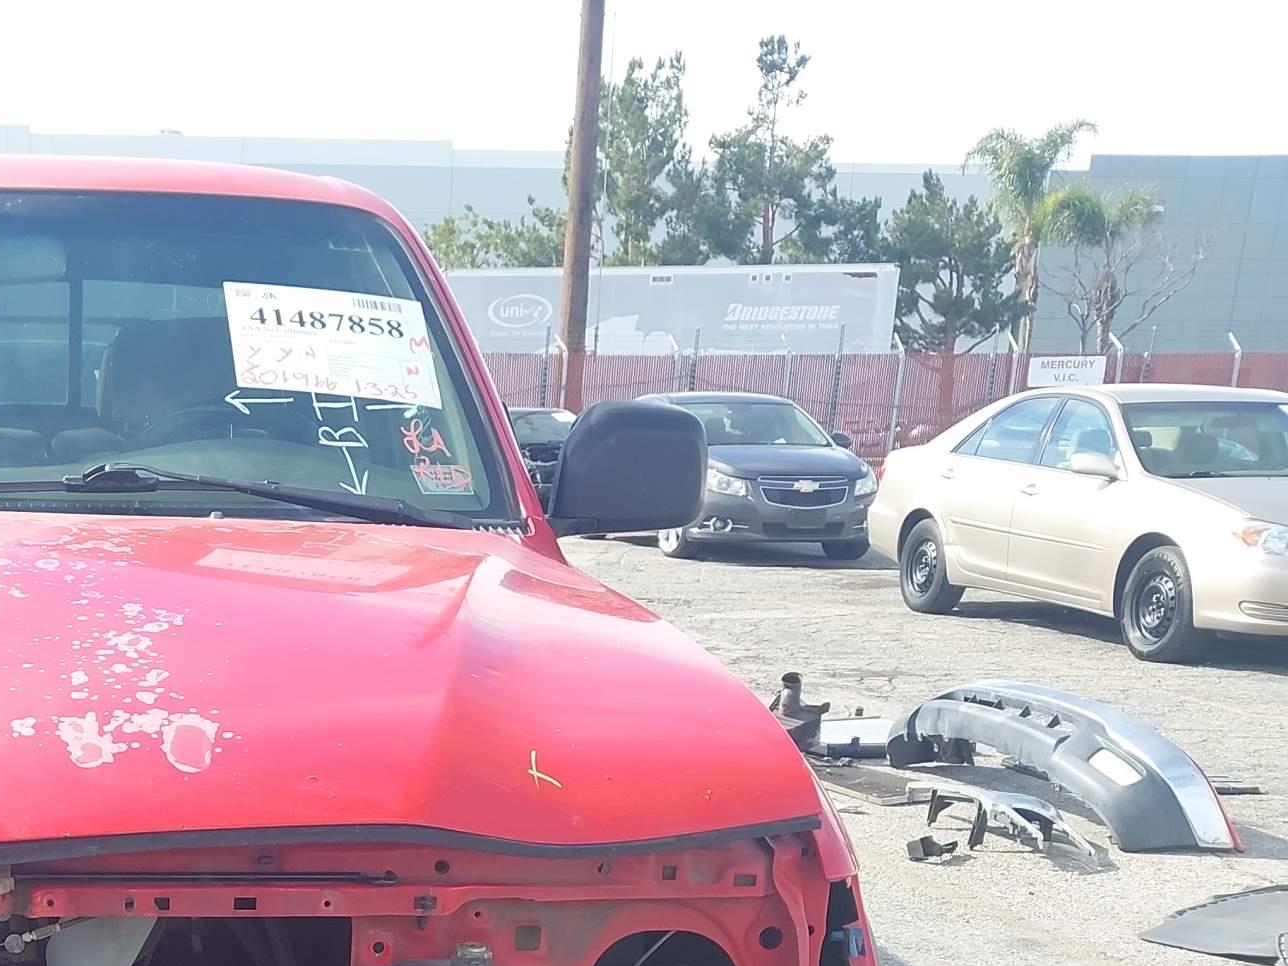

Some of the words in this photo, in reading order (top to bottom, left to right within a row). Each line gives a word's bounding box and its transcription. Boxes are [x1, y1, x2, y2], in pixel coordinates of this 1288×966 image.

[725, 303, 840, 321] BRIDGESTONE
[250, 307, 405, 338] 41487858
[1040, 360, 1095, 369] MERCURY
[1053, 373, 1079, 382] V.I.C.
